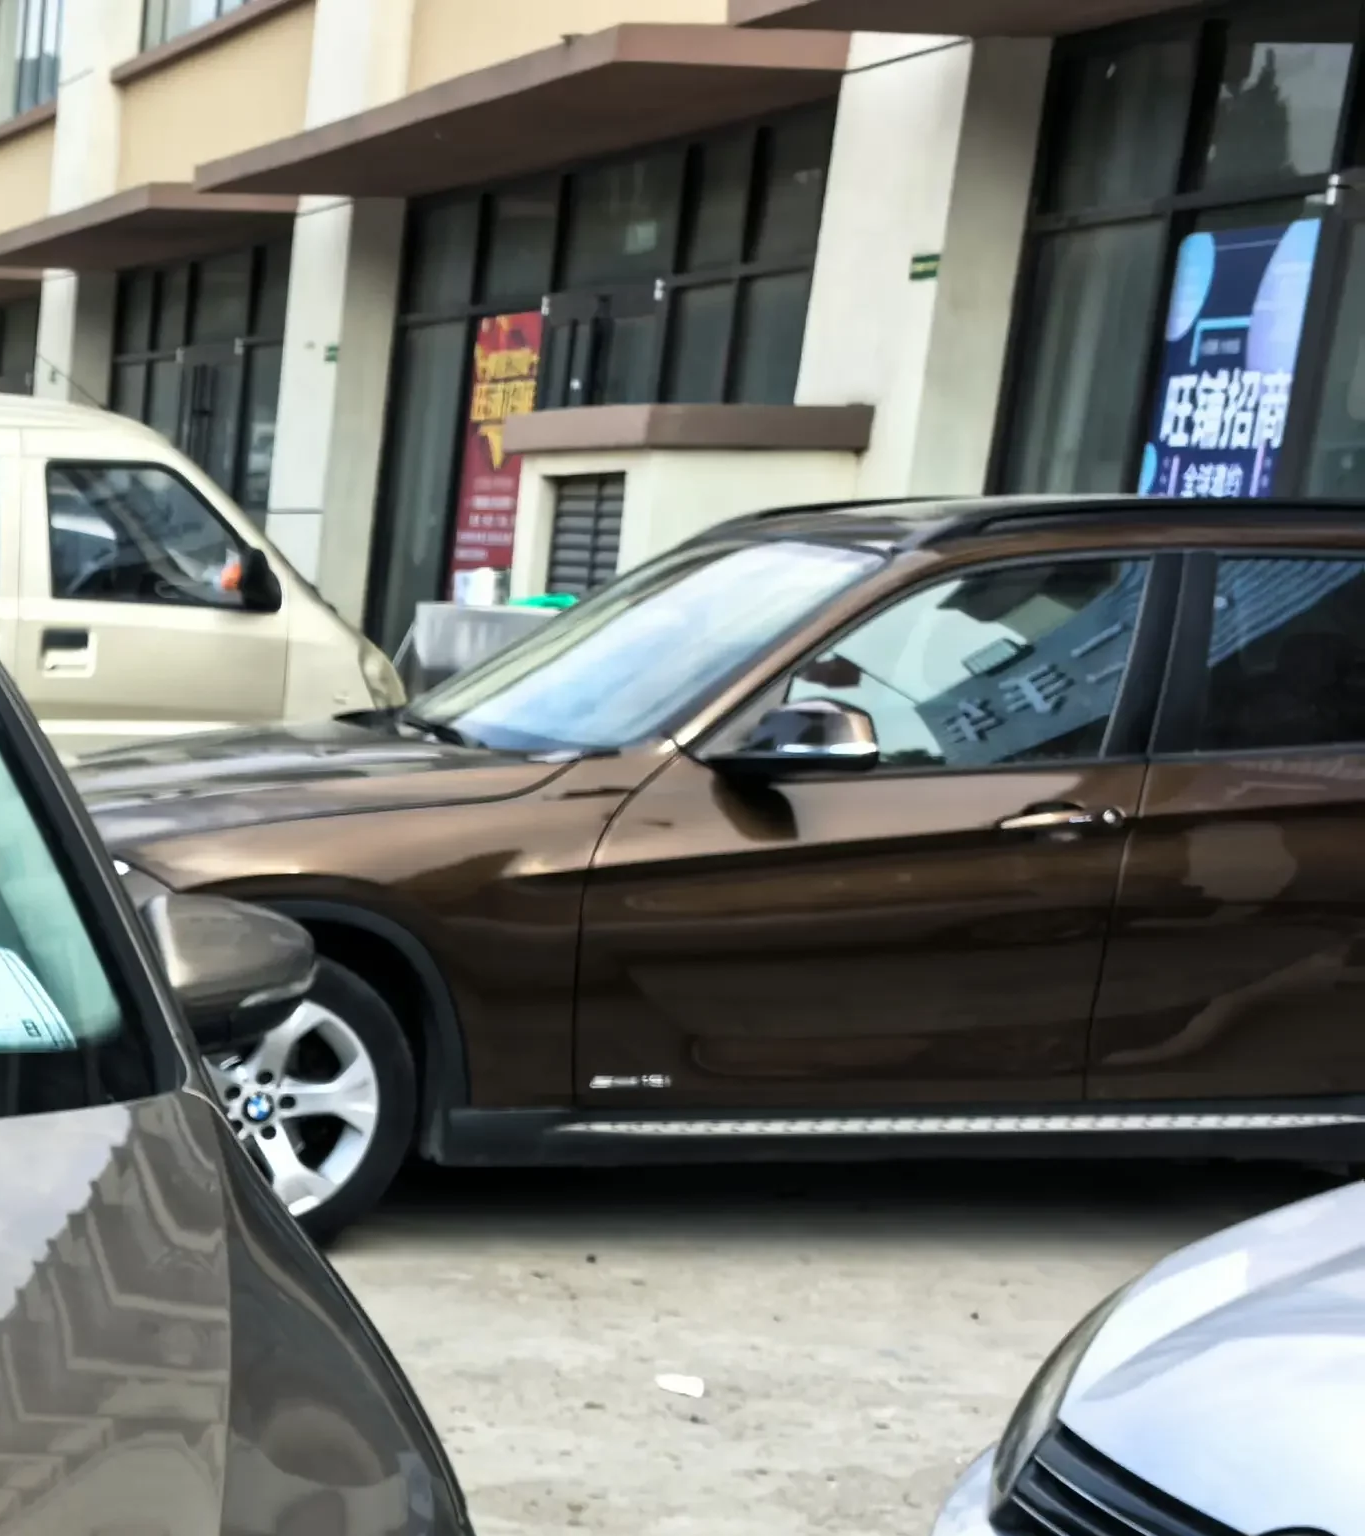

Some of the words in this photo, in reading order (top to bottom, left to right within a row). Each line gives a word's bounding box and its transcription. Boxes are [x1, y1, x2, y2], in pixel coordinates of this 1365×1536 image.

[1159, 367, 1292, 450] 旺铺招商
[22, 1019, 41, 1038] 日
